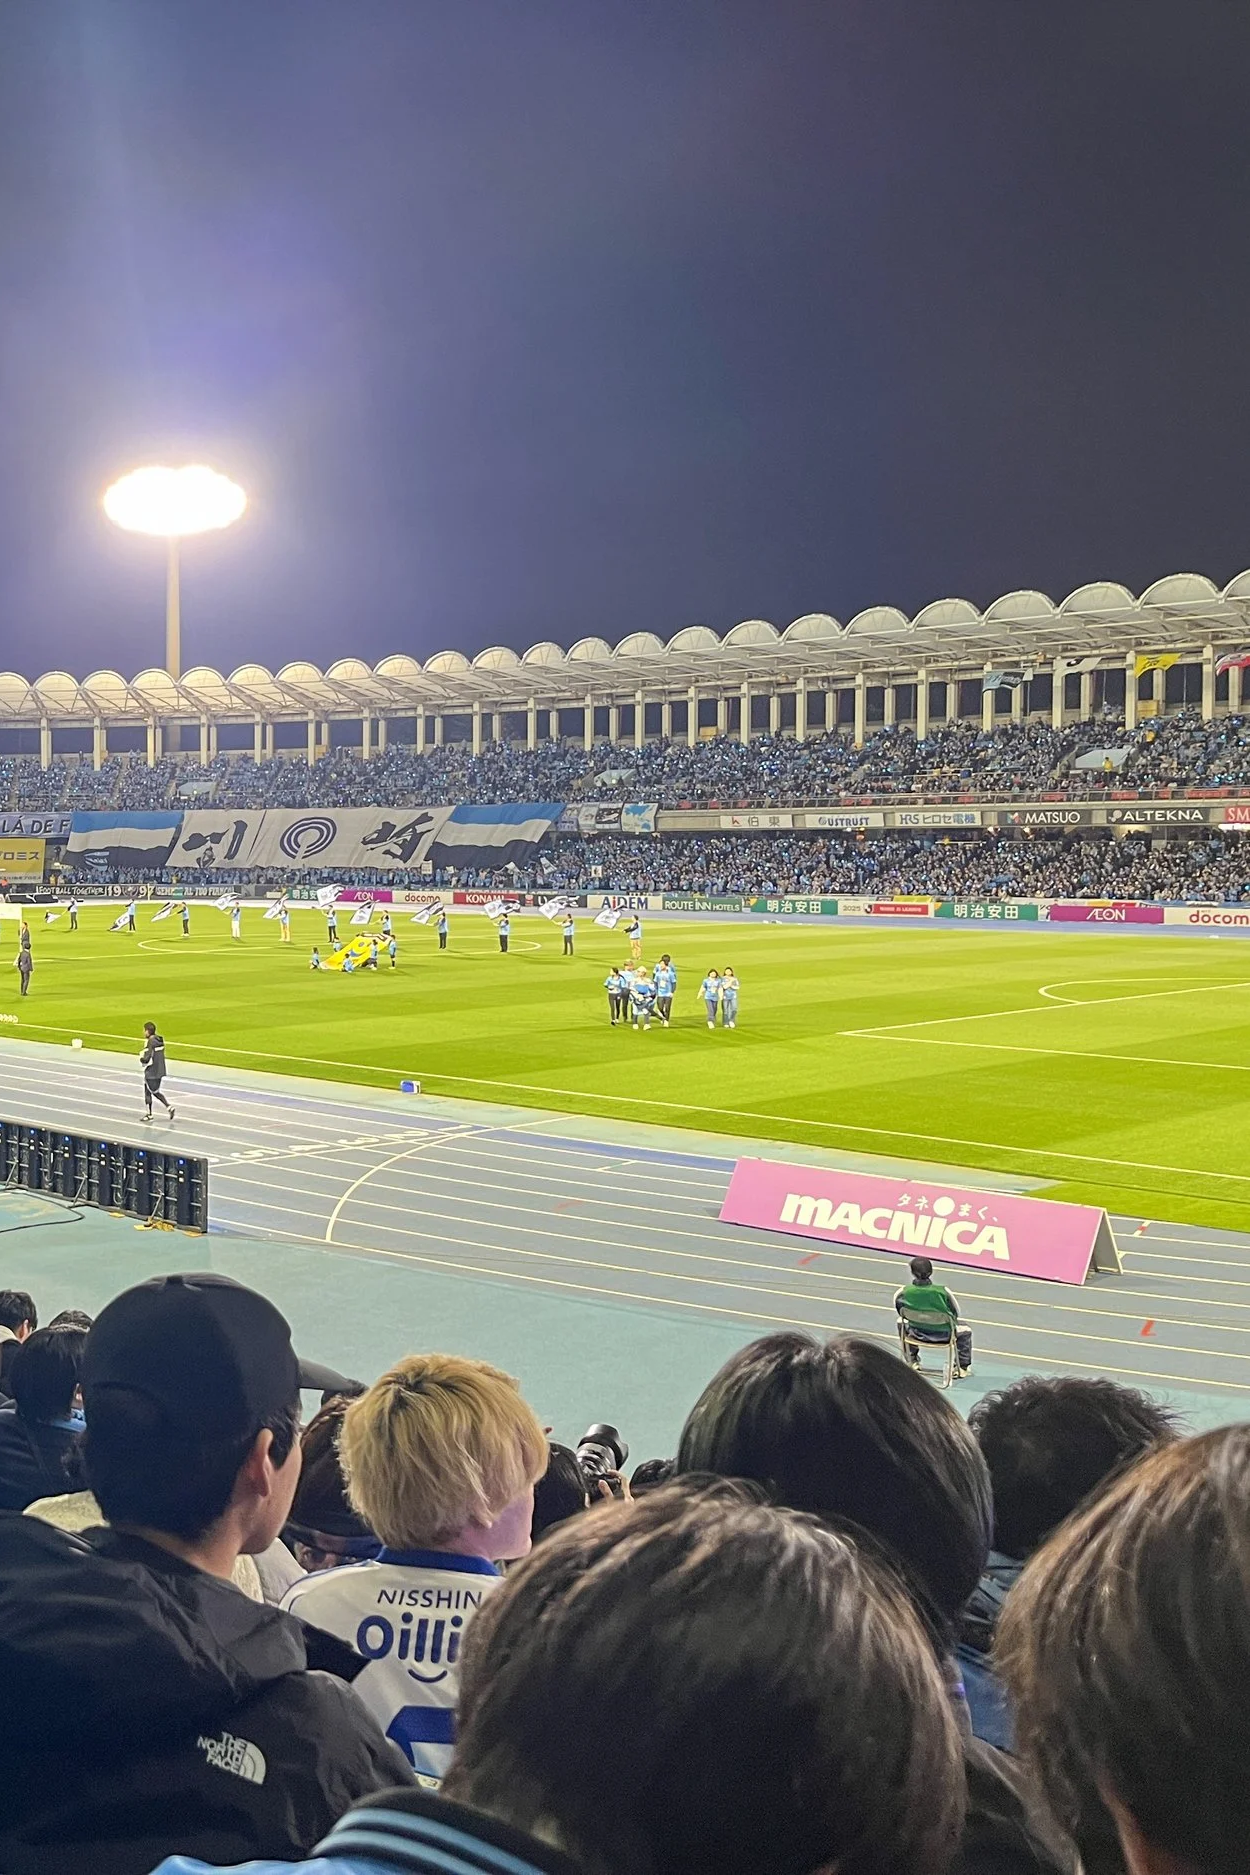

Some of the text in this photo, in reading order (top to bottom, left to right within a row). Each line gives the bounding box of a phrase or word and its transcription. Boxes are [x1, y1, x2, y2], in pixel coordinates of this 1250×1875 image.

[748, 816, 780, 827] 伯東
[923, 813, 976, 825] ヒロセ電機
[1025, 811, 1081, 824] MATSUO
[1123, 809, 1203, 822] ALTEKNA
[2, 815, 26, 834] LÁ
[31, 819, 54, 834] DE
[293, 889, 318, 899] 明治安
[465, 893, 505, 903] KONAMI
[664, 900, 694, 911] ROUTE
[713, 903, 740, 912] HOTELS
[766, 900, 822, 914] 明治安田
[954, 904, 1019, 919] 明治安田
[377, 1588, 483, 1610] NISSHIN
[356, 1612, 461, 1664] Oilli
[197, 1735, 245, 1763] NORTH
[206, 1751, 240, 1775] FACE
